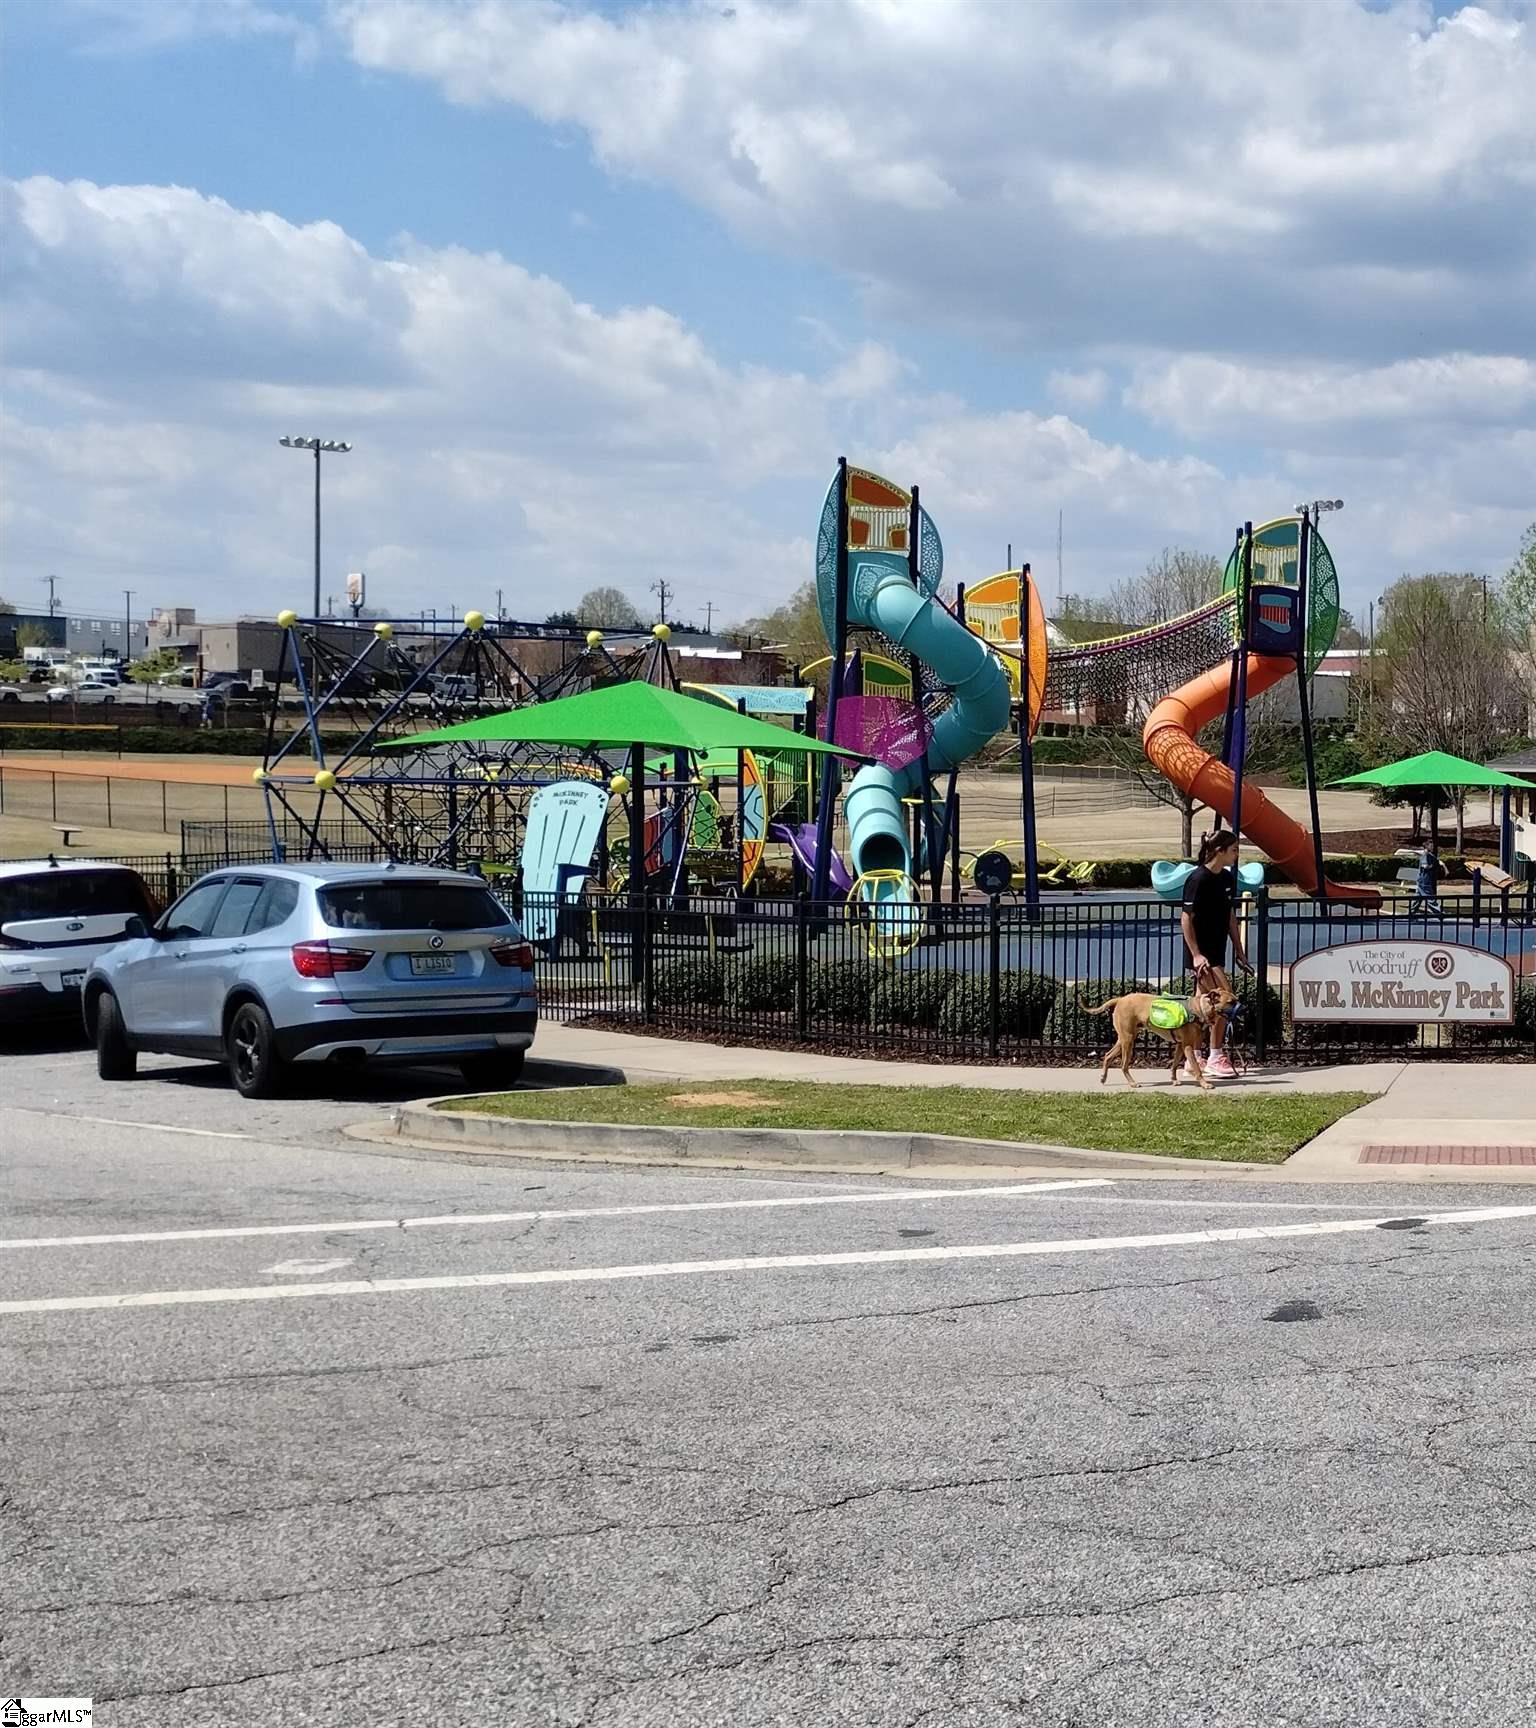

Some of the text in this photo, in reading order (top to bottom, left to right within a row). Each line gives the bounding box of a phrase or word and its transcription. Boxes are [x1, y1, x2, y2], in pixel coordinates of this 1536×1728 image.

[1363, 950, 1406, 960] The City of
[1348, 958, 1422, 978] Woodruff
[1299, 980, 1505, 1018] W.R. McKinney Park
